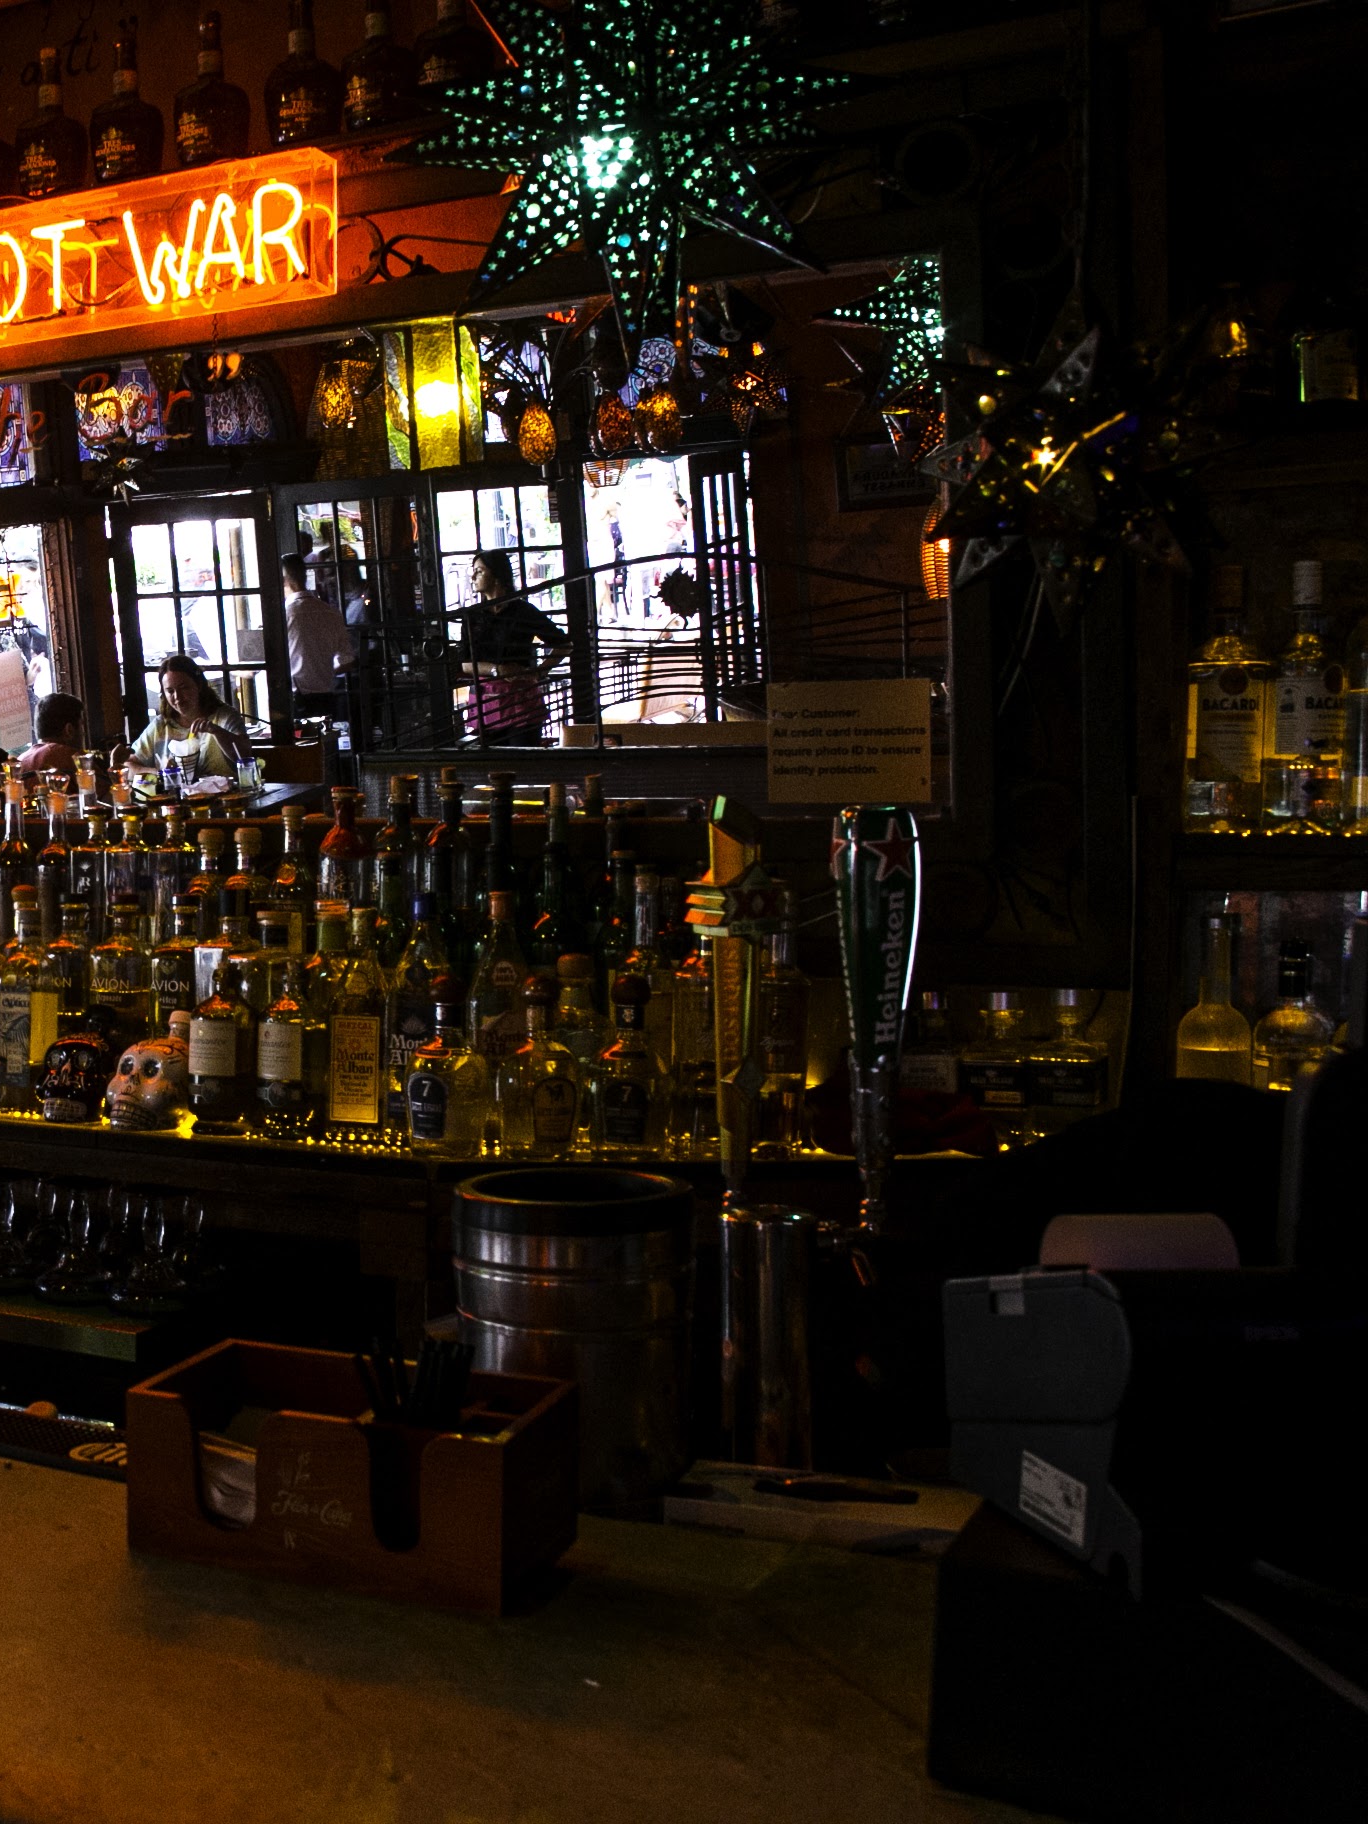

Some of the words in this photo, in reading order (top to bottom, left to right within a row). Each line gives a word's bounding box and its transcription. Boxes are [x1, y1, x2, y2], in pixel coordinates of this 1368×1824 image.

[121, 181, 306, 306] WAR
[800, 708, 861, 719] Customer:
[790, 726, 823, 738] credit
[825, 726, 851, 738] card
[854, 725, 927, 737] transactions
[772, 746, 813, 758] require
[815, 745, 849, 758] photo
[881, 746, 922, 756] ensure
[772, 765, 814, 777] identity
[873, 887, 906, 1045] Heineken
[421, 1080, 433, 1097] 7
[621, 1085, 633, 1103] 7
